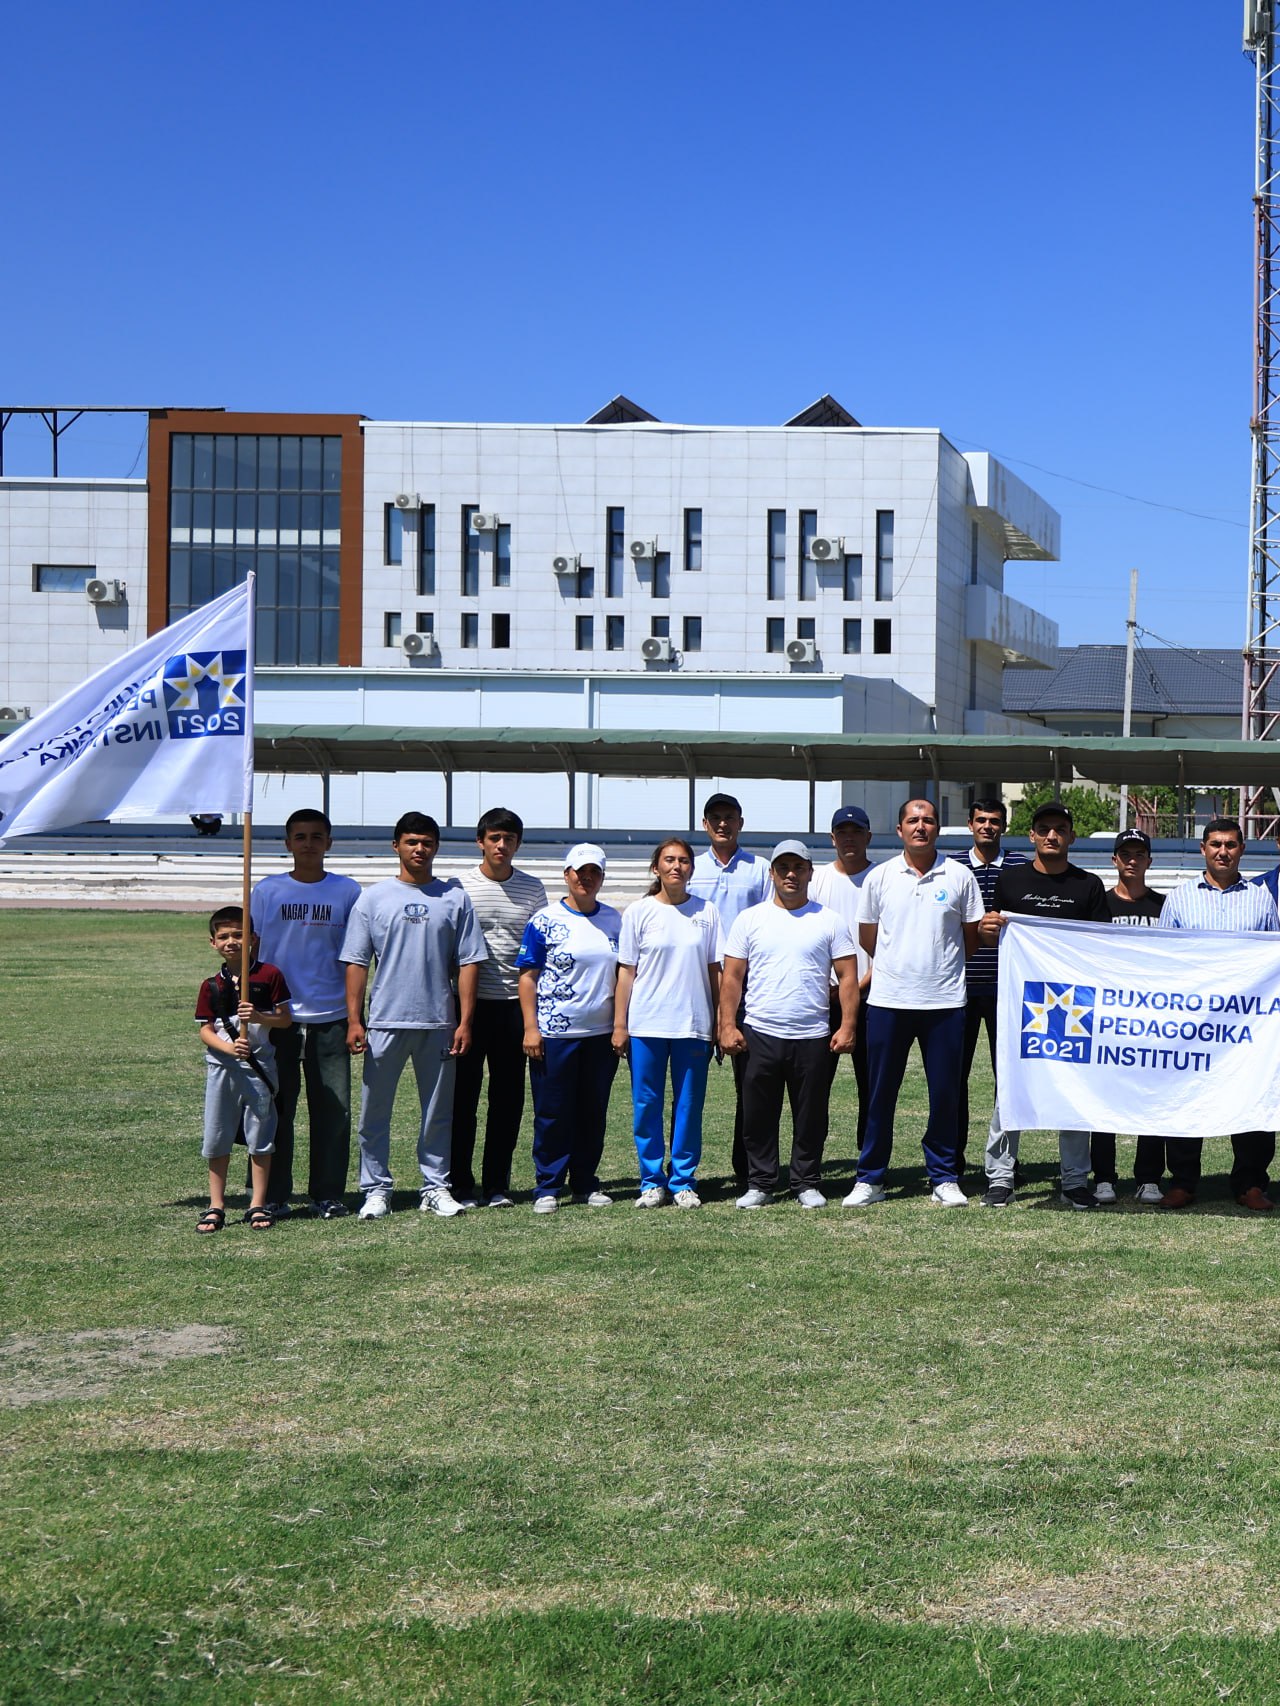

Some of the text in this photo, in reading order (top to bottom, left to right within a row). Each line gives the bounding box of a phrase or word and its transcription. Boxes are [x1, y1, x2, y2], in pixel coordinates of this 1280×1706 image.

[281, 903, 332, 920] NAGAP MAN
[1101, 988, 1203, 1012] BUXORO
[1099, 1016, 1253, 1043] PEDAGOGIKA
[1026, 1036, 1085, 1059] 2021
[1097, 1045, 1212, 1072] INSTITUTI
